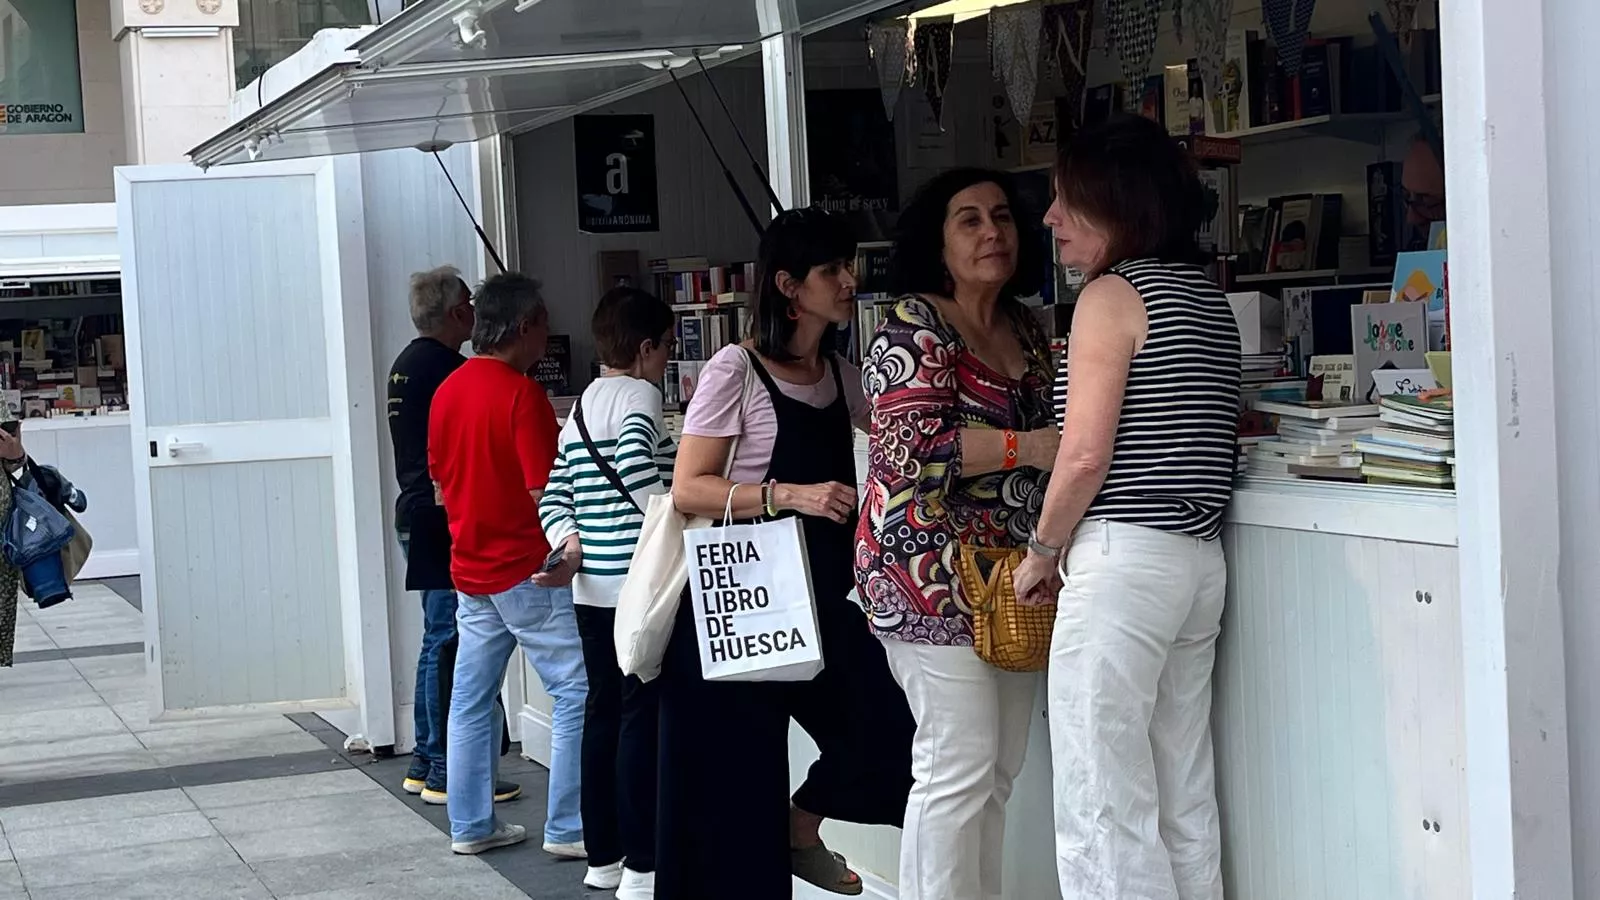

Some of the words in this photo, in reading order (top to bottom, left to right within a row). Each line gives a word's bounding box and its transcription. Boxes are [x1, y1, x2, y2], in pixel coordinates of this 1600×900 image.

[6, 104, 63, 114] GOBIERNO
[7, 114, 22, 123] DE
[606, 152, 629, 195] a
[863, 197, 889, 212] sexy
[696, 541, 760, 567] FERIA
[699, 566, 741, 590] DEL
[702, 586, 769, 615] LIBRO
[706, 615, 736, 638] DE
[710, 627, 806, 662] HUESCA
